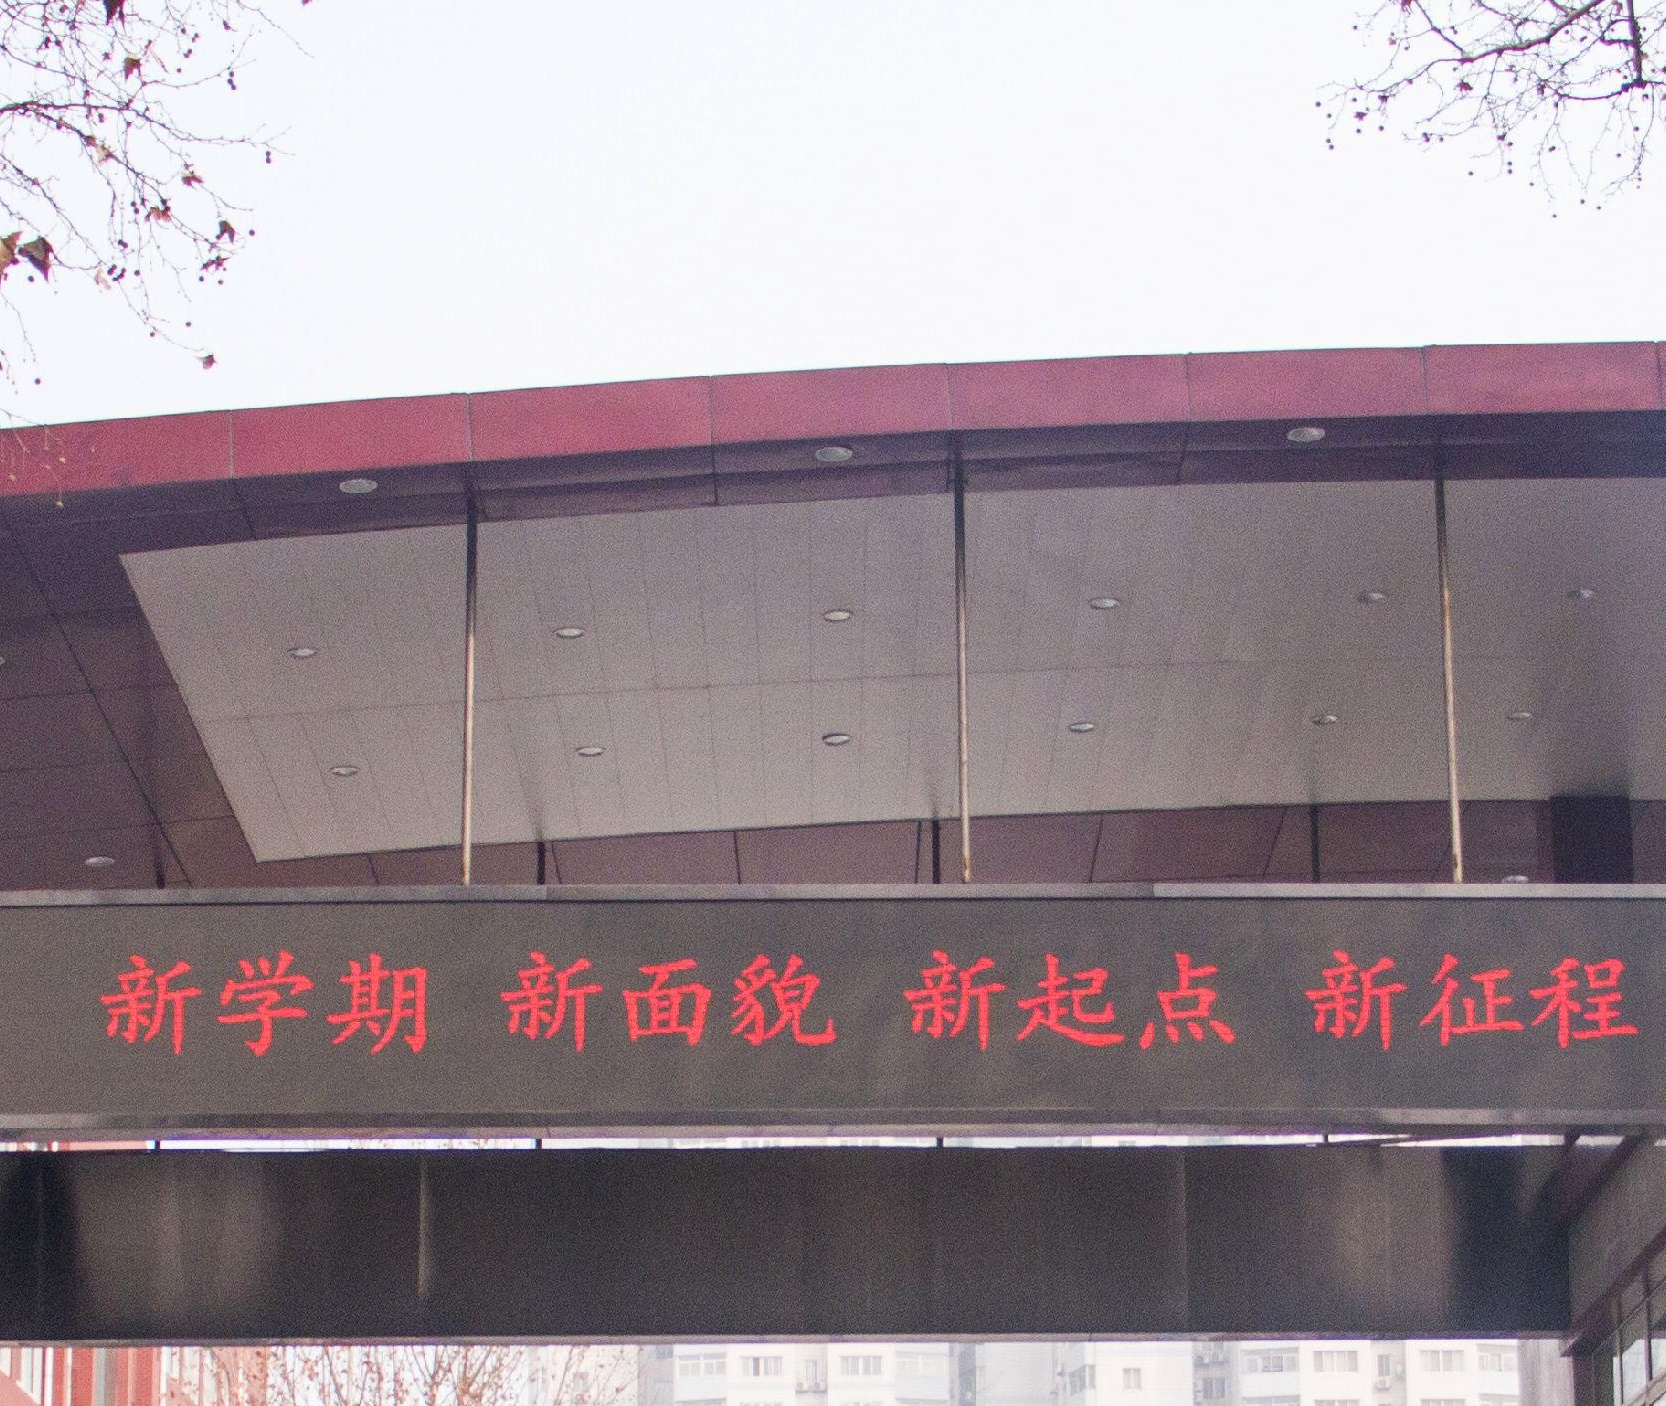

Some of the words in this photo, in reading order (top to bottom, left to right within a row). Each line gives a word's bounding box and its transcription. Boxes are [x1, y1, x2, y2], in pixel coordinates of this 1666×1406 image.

[100, 950, 429, 1058] 新学期
[500, 951, 838, 1053] 新面貌
[904, 950, 1237, 1051] 新起点
[1306, 950, 1640, 1051] 新征程
